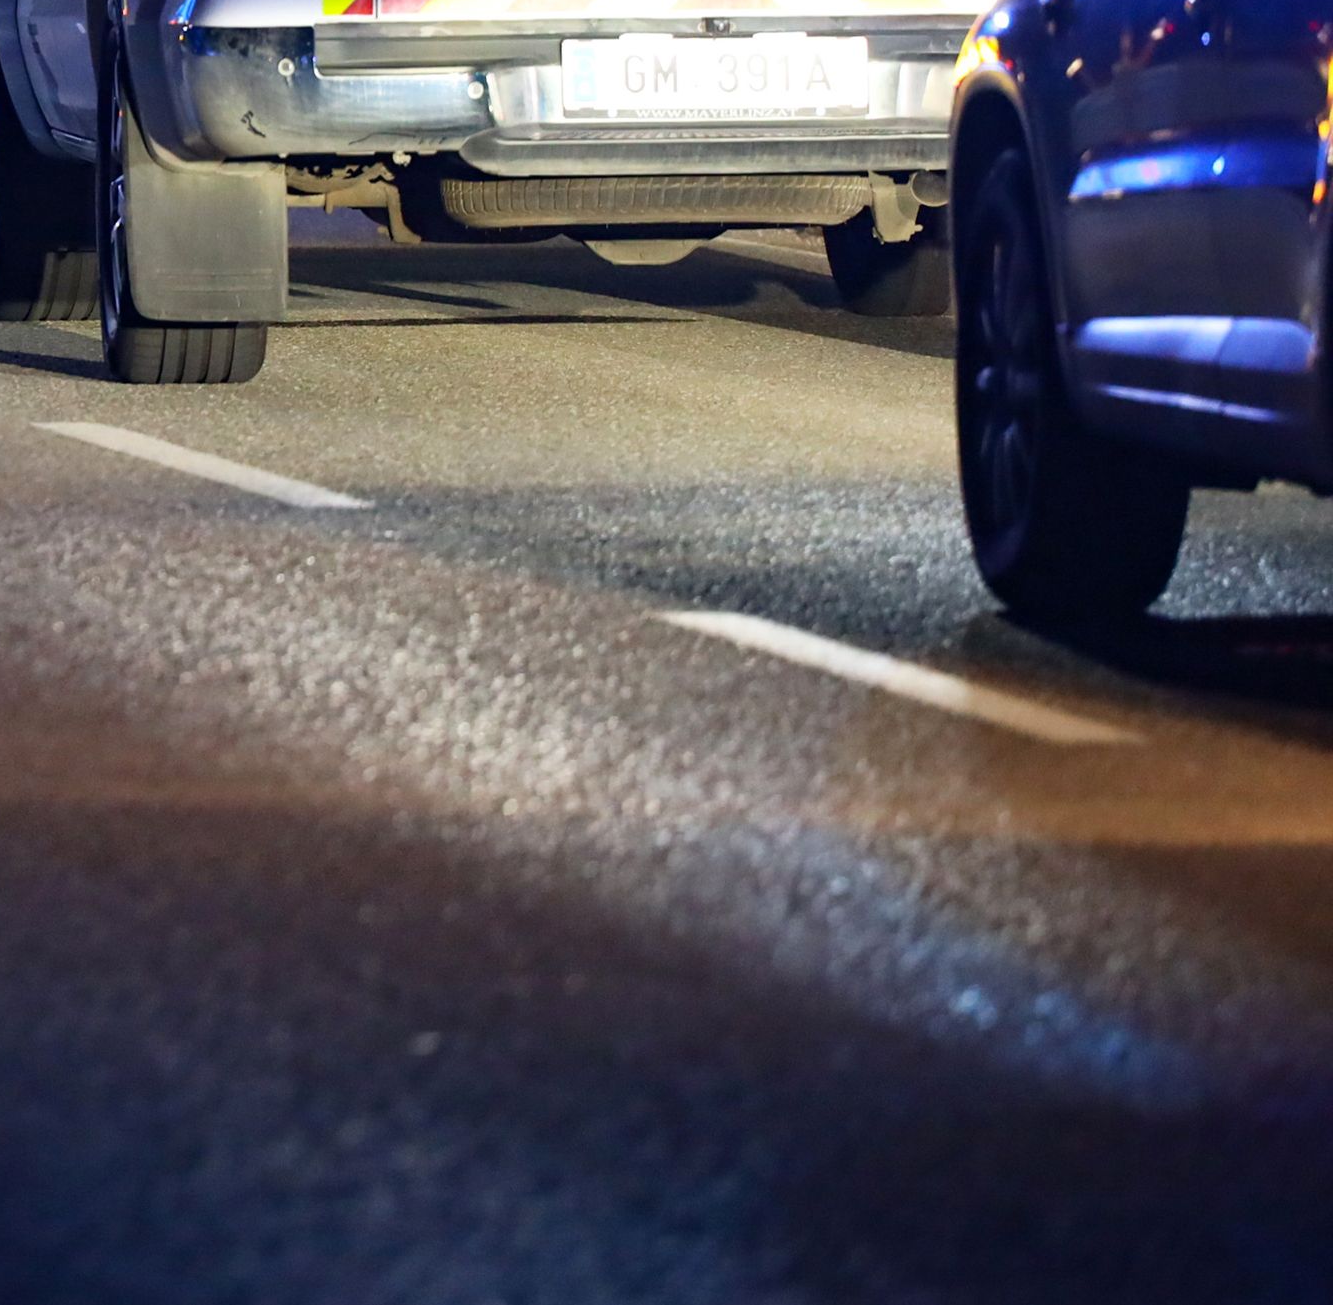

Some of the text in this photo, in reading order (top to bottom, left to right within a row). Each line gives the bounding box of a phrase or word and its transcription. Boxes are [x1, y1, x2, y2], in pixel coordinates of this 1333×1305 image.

[624, 53, 832, 94] GM 391 A
